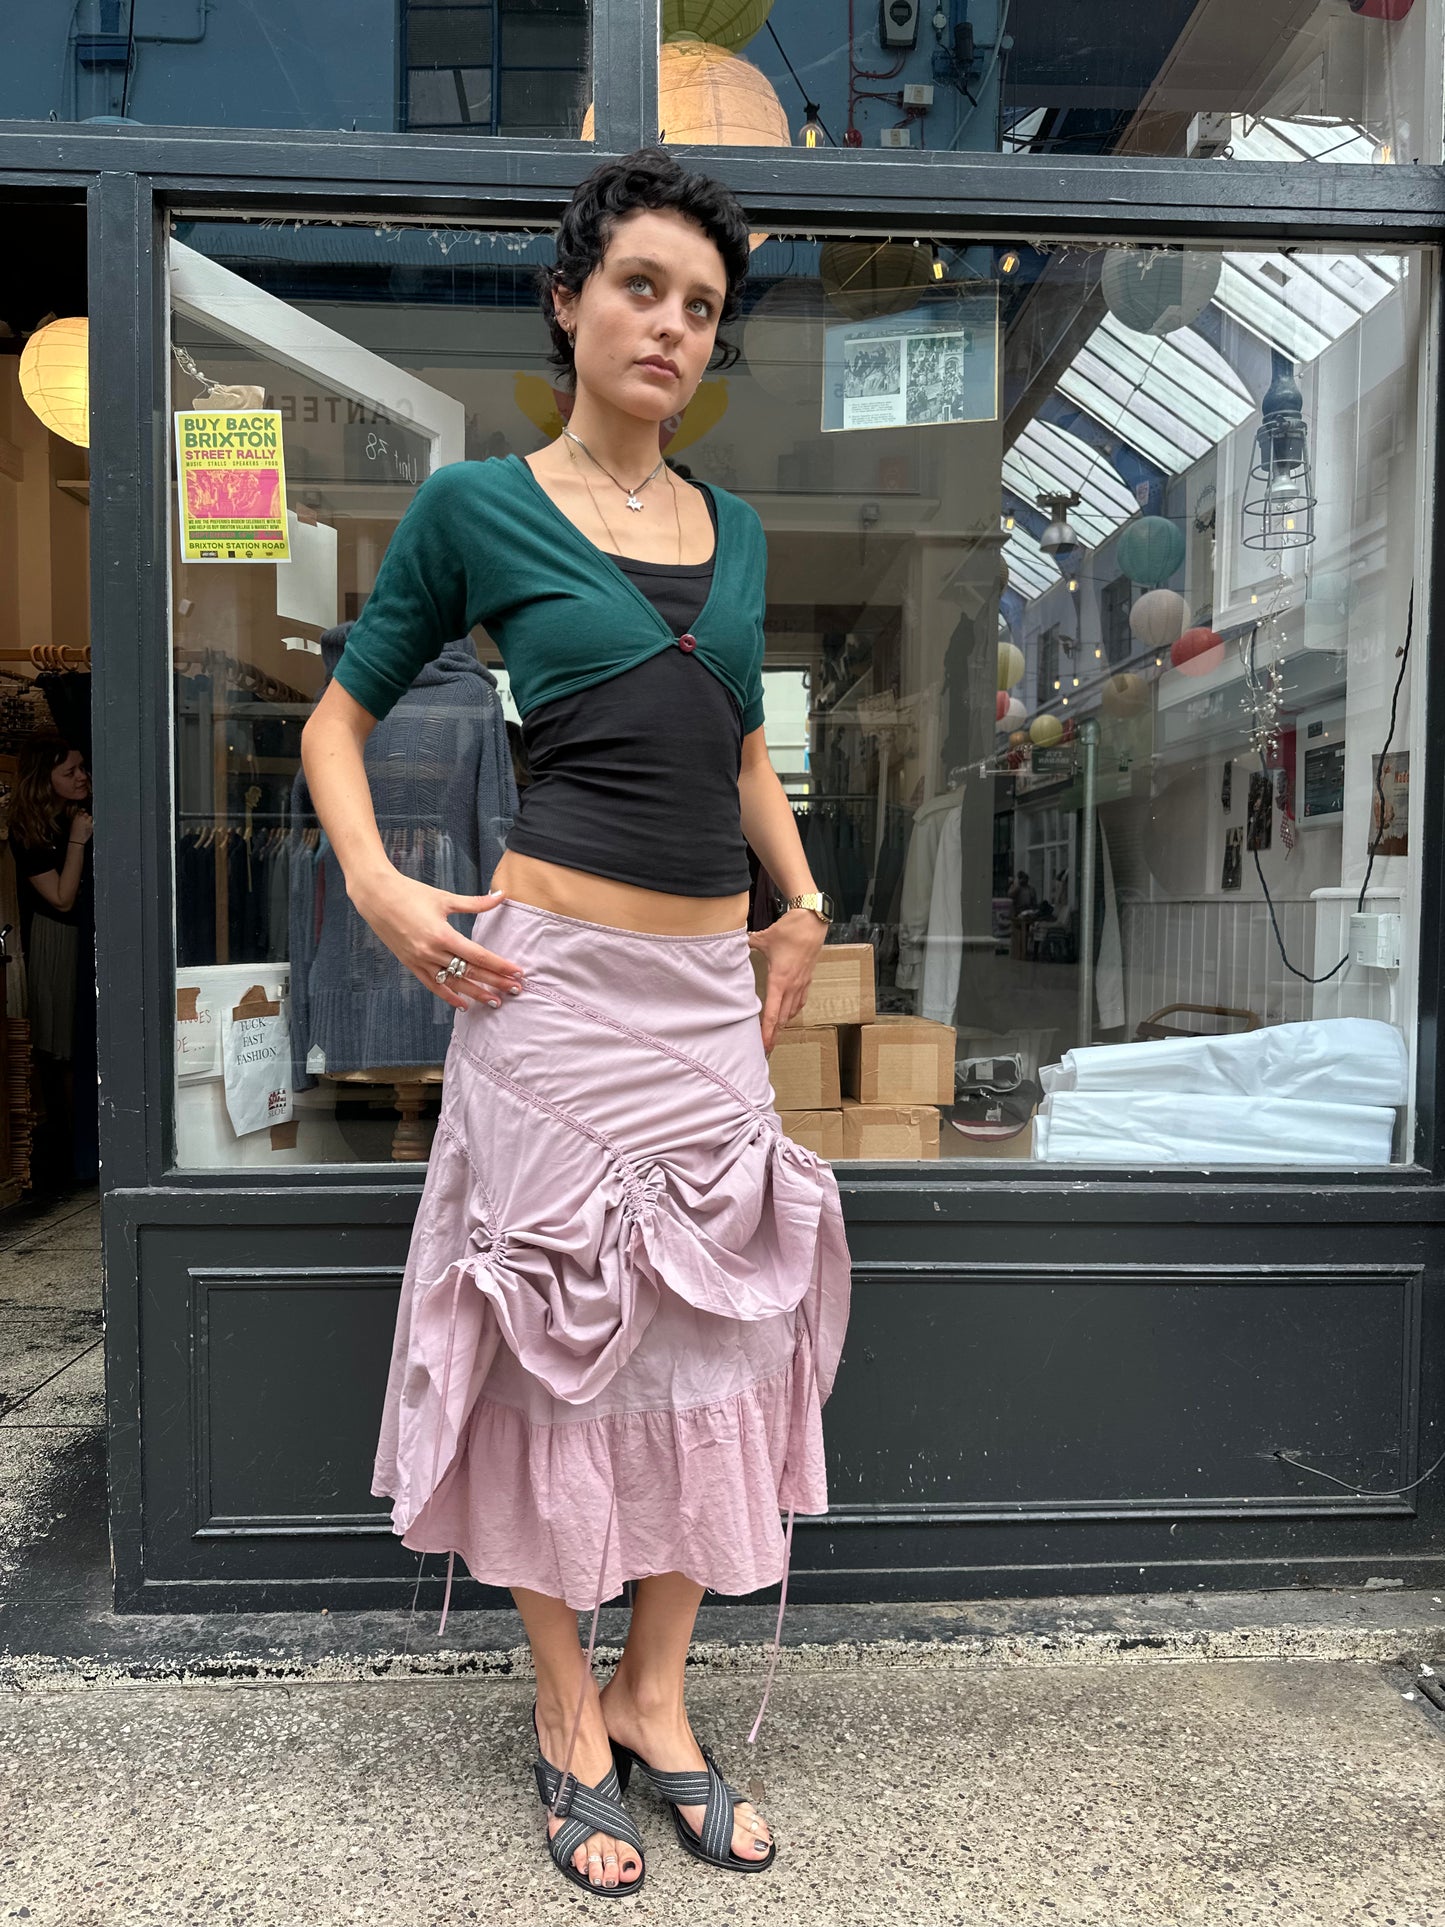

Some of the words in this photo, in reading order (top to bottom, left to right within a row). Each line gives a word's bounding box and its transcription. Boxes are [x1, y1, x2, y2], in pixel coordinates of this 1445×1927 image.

[184, 418, 220, 431] BUY
[226, 417, 275, 431] BACK
[185, 432, 277, 448] BRIXTON
[185, 450, 232, 460] STREET
[237, 450, 276, 459] RALLY
[243, 1033, 265, 1047] FAST
[237, 1046, 277, 1065] FASHION
